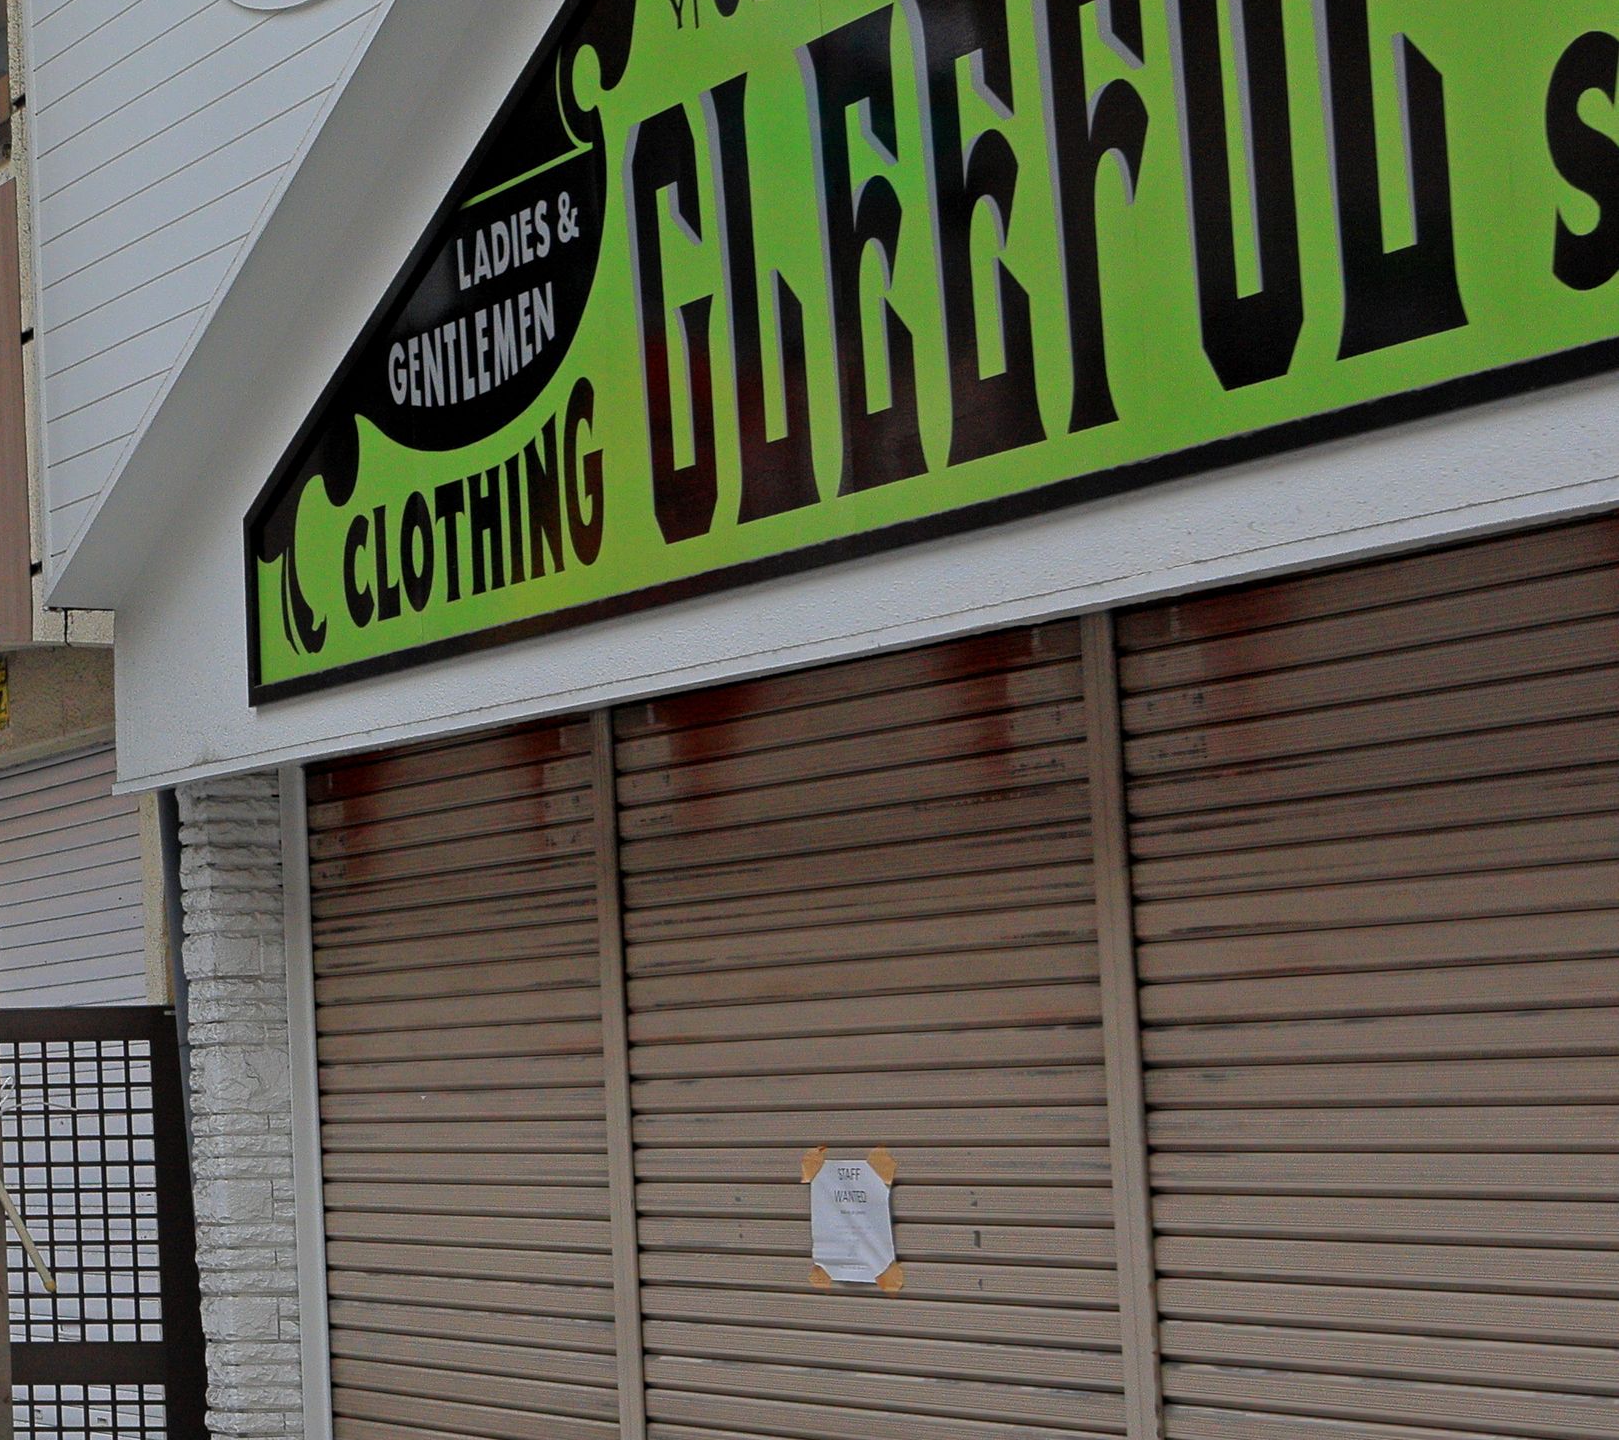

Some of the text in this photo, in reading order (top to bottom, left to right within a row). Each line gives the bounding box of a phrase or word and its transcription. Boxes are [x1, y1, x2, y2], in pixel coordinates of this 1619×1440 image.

[455, 188, 581, 290] LADIES &
[386, 283, 557, 410] GENTLEMEN
[342, 375, 606, 628] CLOTHING
[833, 1190, 867, 1203] WANTED
[837, 1167, 861, 1181] STAFF
